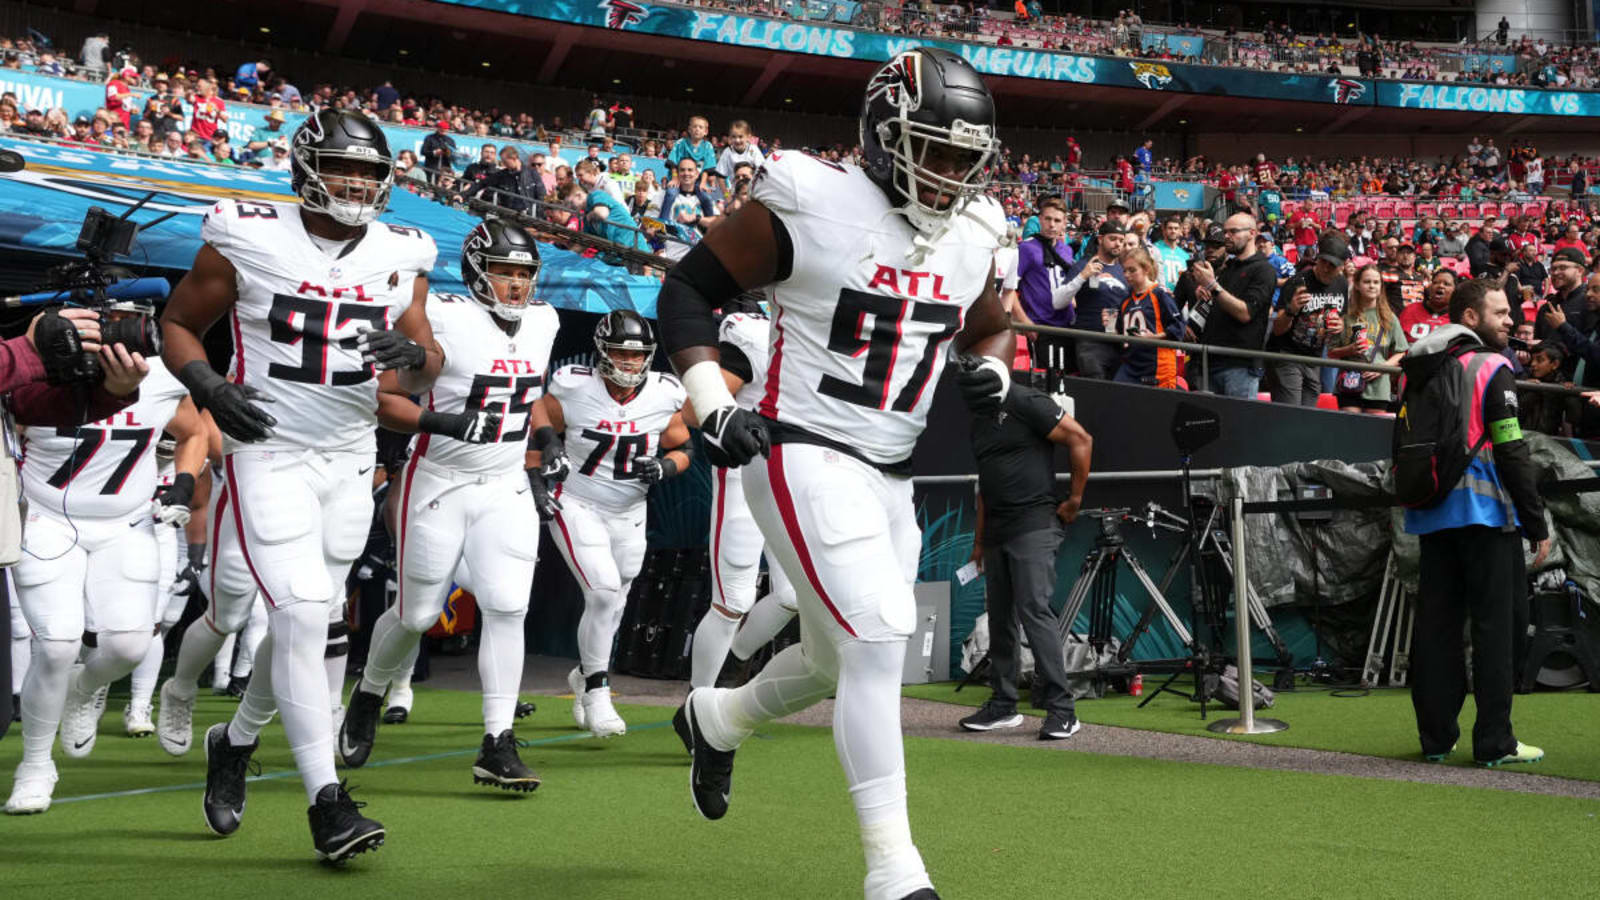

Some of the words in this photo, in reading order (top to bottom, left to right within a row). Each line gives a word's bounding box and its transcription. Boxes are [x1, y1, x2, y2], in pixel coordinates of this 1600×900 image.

[691, 10, 855, 58] FALCONS
[961, 45, 1096, 83] JAGUARS
[1400, 83, 1526, 113] FALCONS
[1551, 94, 1580, 113] VS
[867, 262, 951, 301] ATL
[267, 293, 390, 387] 93
[490, 359, 536, 374] ATL
[816, 286, 964, 415] 97
[465, 373, 545, 443] 55
[596, 419, 641, 434] ATL
[46, 427, 156, 496] 77
[578, 428, 650, 481] 70
